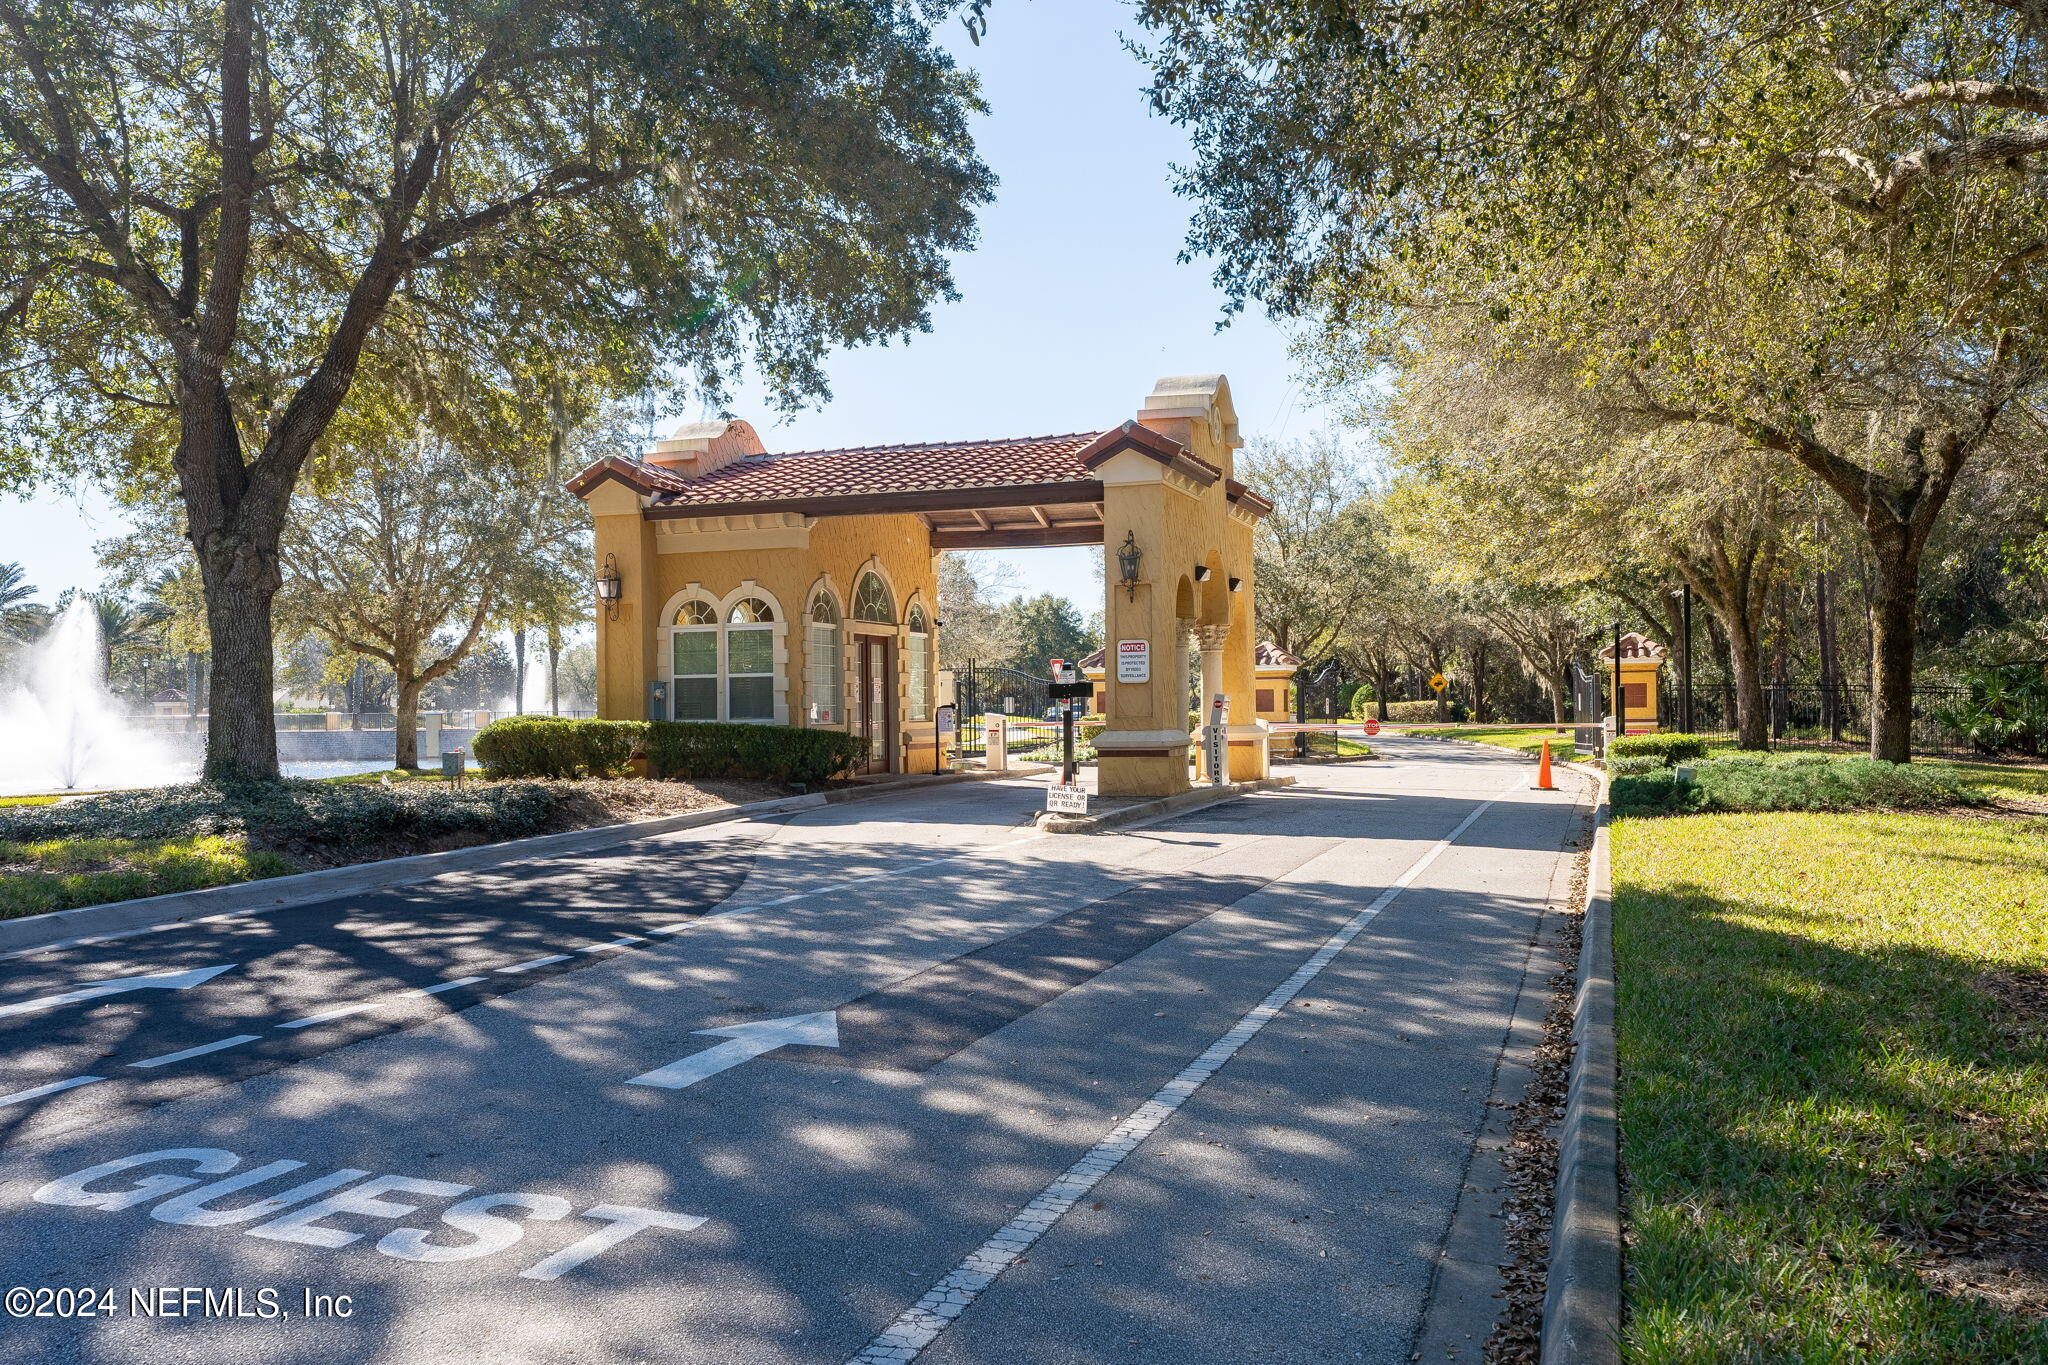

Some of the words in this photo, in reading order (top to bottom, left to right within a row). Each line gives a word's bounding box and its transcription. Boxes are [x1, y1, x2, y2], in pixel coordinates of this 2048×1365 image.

[1212, 727, 1220, 783] VISITORS
[1048, 792, 1073, 800] LICENSE
[32, 1147, 710, 1282] GUEST
